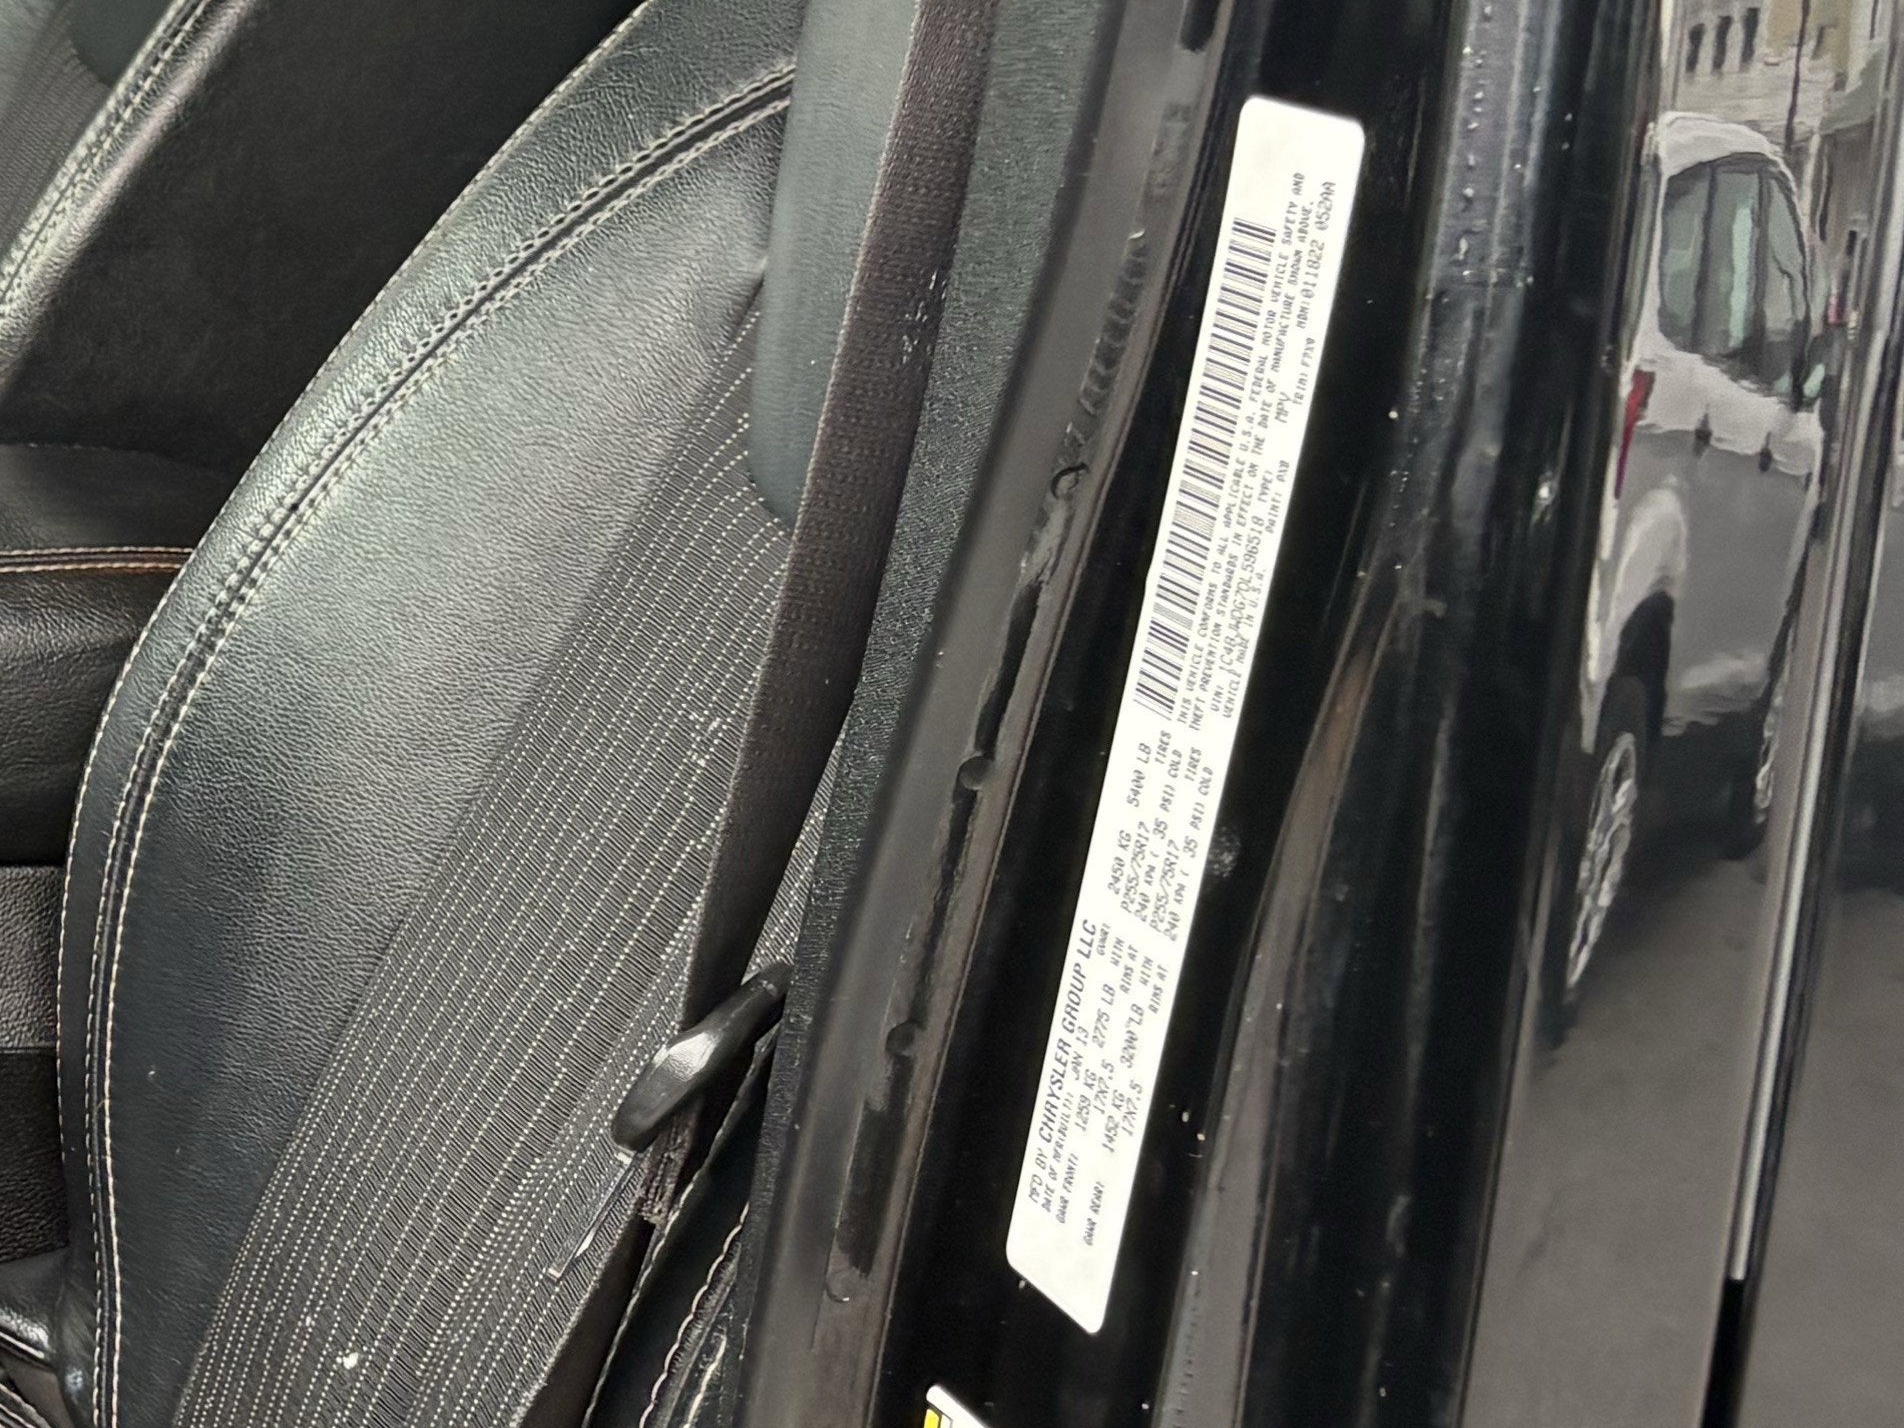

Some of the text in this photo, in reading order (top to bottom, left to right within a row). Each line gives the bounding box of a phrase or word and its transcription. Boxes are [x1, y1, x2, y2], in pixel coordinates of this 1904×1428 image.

[1106, 854, 1126, 895] 2450
[1116, 829, 1132, 851] KG
[1135, 741, 1152, 764] LB
[1076, 918, 1097, 960] LLC
[1061, 960, 1089, 1034] GROUP
[1101, 983, 1117, 1006] LB
[1091, 1009, 1111, 1049] 2775
[1110, 1088, 1126, 1110] KG
[1128, 1003, 1145, 1026] LB
[1037, 1038, 1072, 1144] CHRYSLER
[1082, 1068, 1098, 1090] KG
[1073, 1093, 1092, 1132] 1259
[1034, 1147, 1049, 1169] BY
